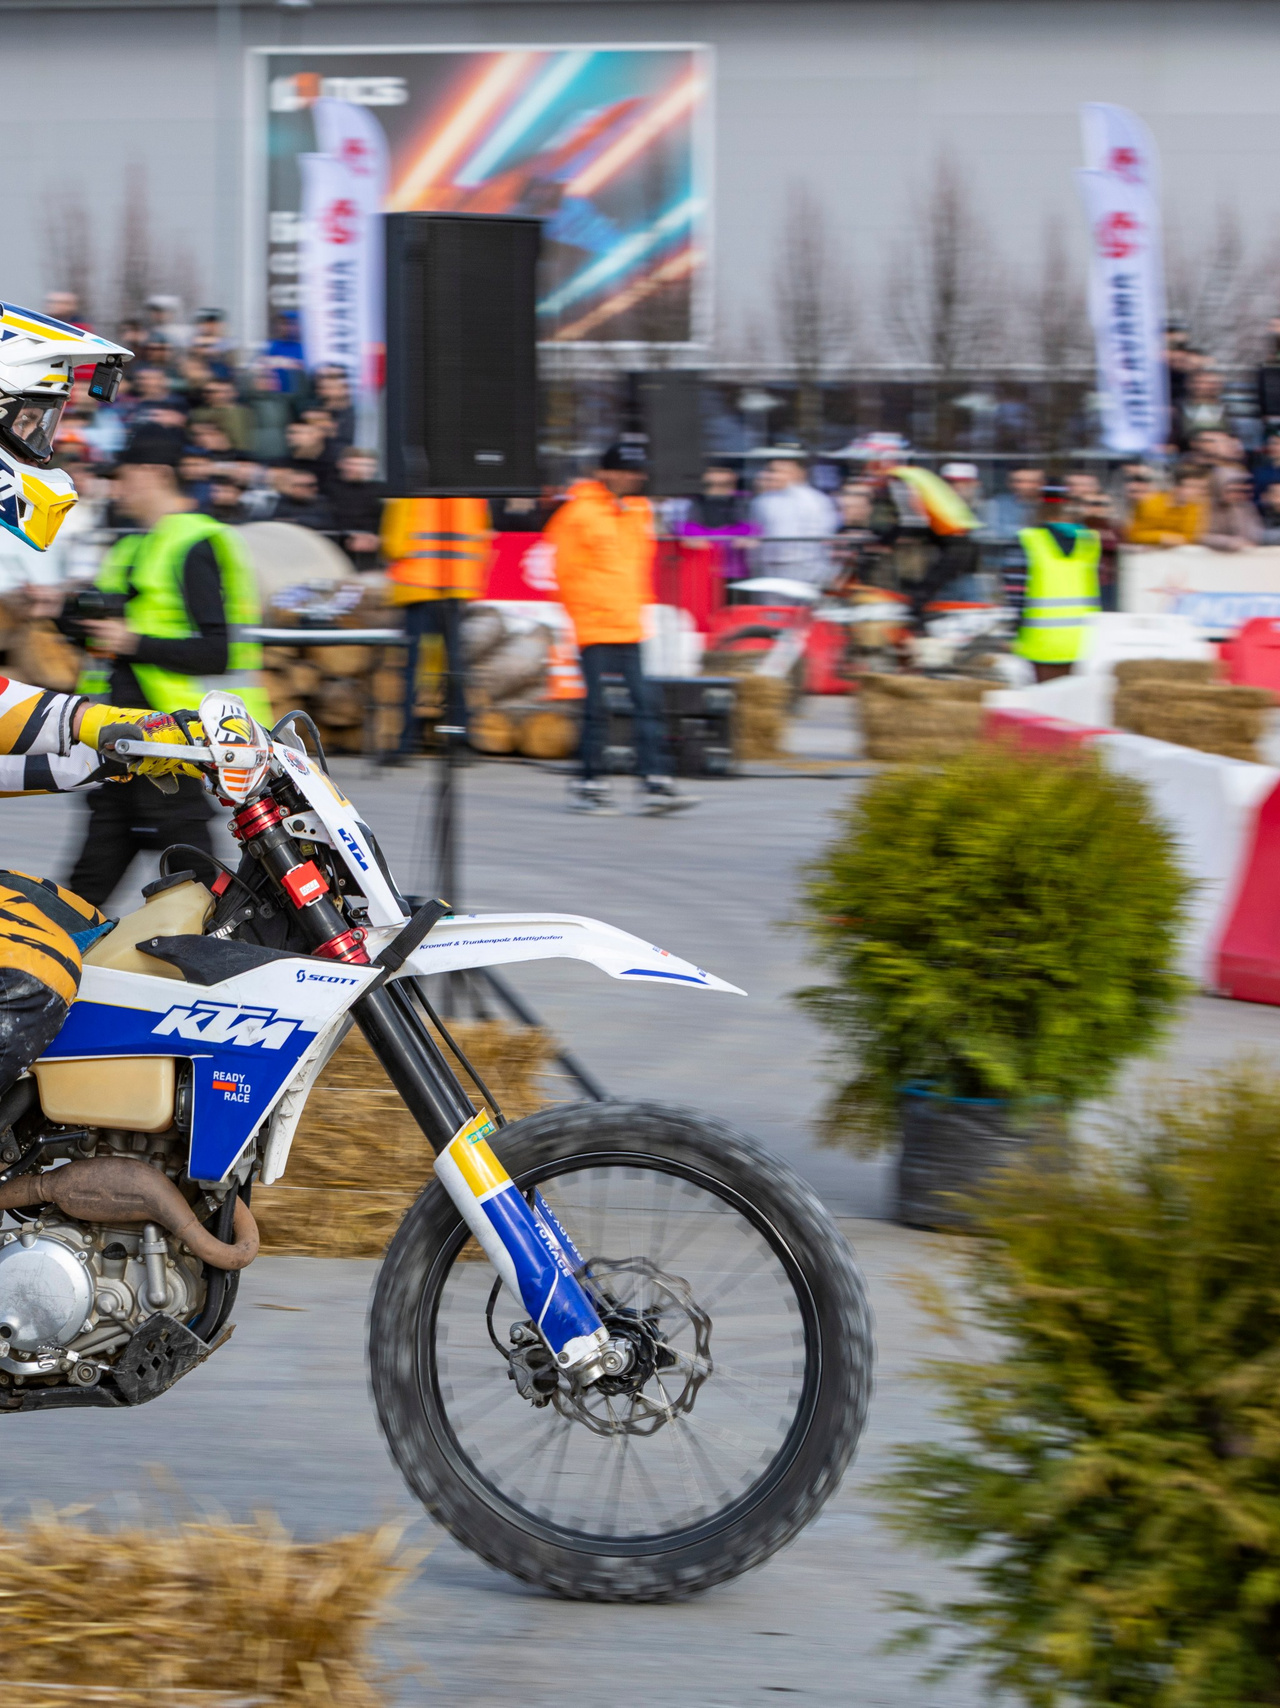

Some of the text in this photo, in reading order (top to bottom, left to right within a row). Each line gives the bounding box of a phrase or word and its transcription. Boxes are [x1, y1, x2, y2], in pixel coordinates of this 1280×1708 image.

[337, 828, 370, 872] KTM
[419, 941, 452, 950] Kronreif
[462, 937, 511, 945] Trunkenpolz
[307, 974, 359, 985] SCOTT
[151, 1003, 298, 1050] KTM
[213, 1070, 246, 1083] READY
[238, 1084, 251, 1094] TO
[224, 1092, 250, 1103] RACE
[545, 1239, 571, 1278] RACE
